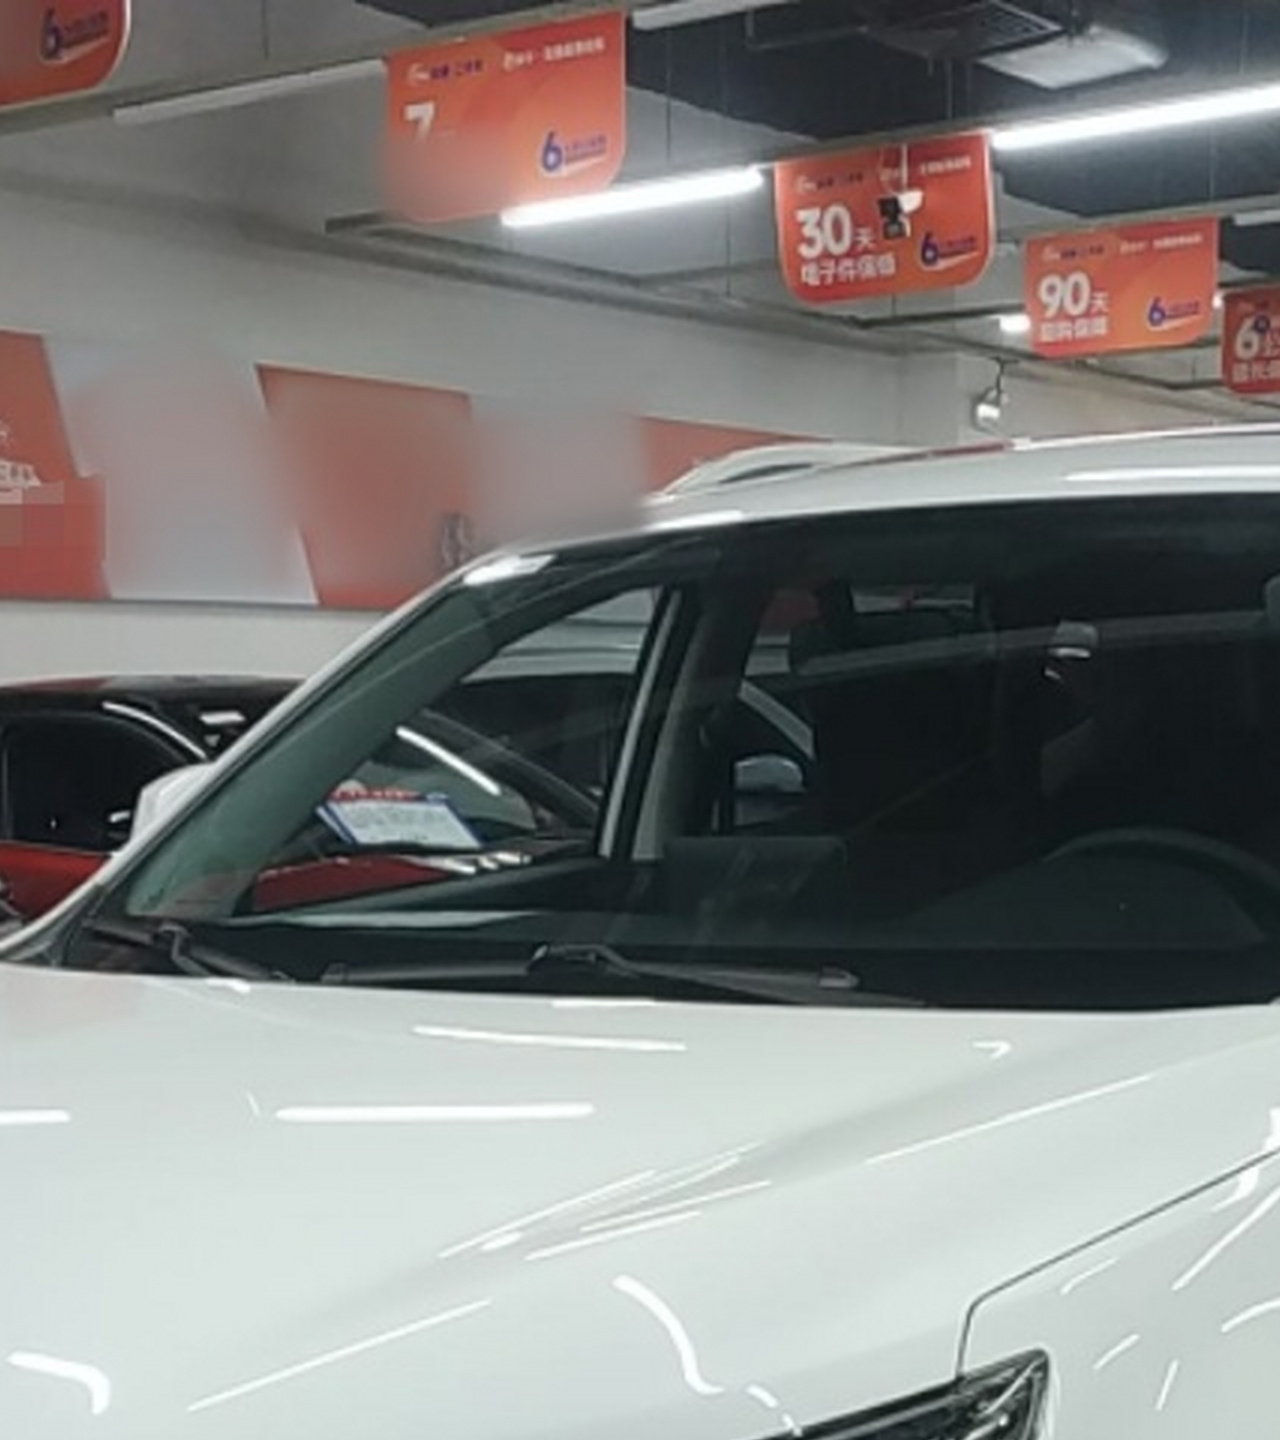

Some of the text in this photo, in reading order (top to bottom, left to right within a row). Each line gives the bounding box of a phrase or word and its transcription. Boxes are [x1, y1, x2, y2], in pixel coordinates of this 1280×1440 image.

[541, 131, 564, 172] 6
[920, 231, 941, 268] 6
[1148, 297, 1167, 327] 6
